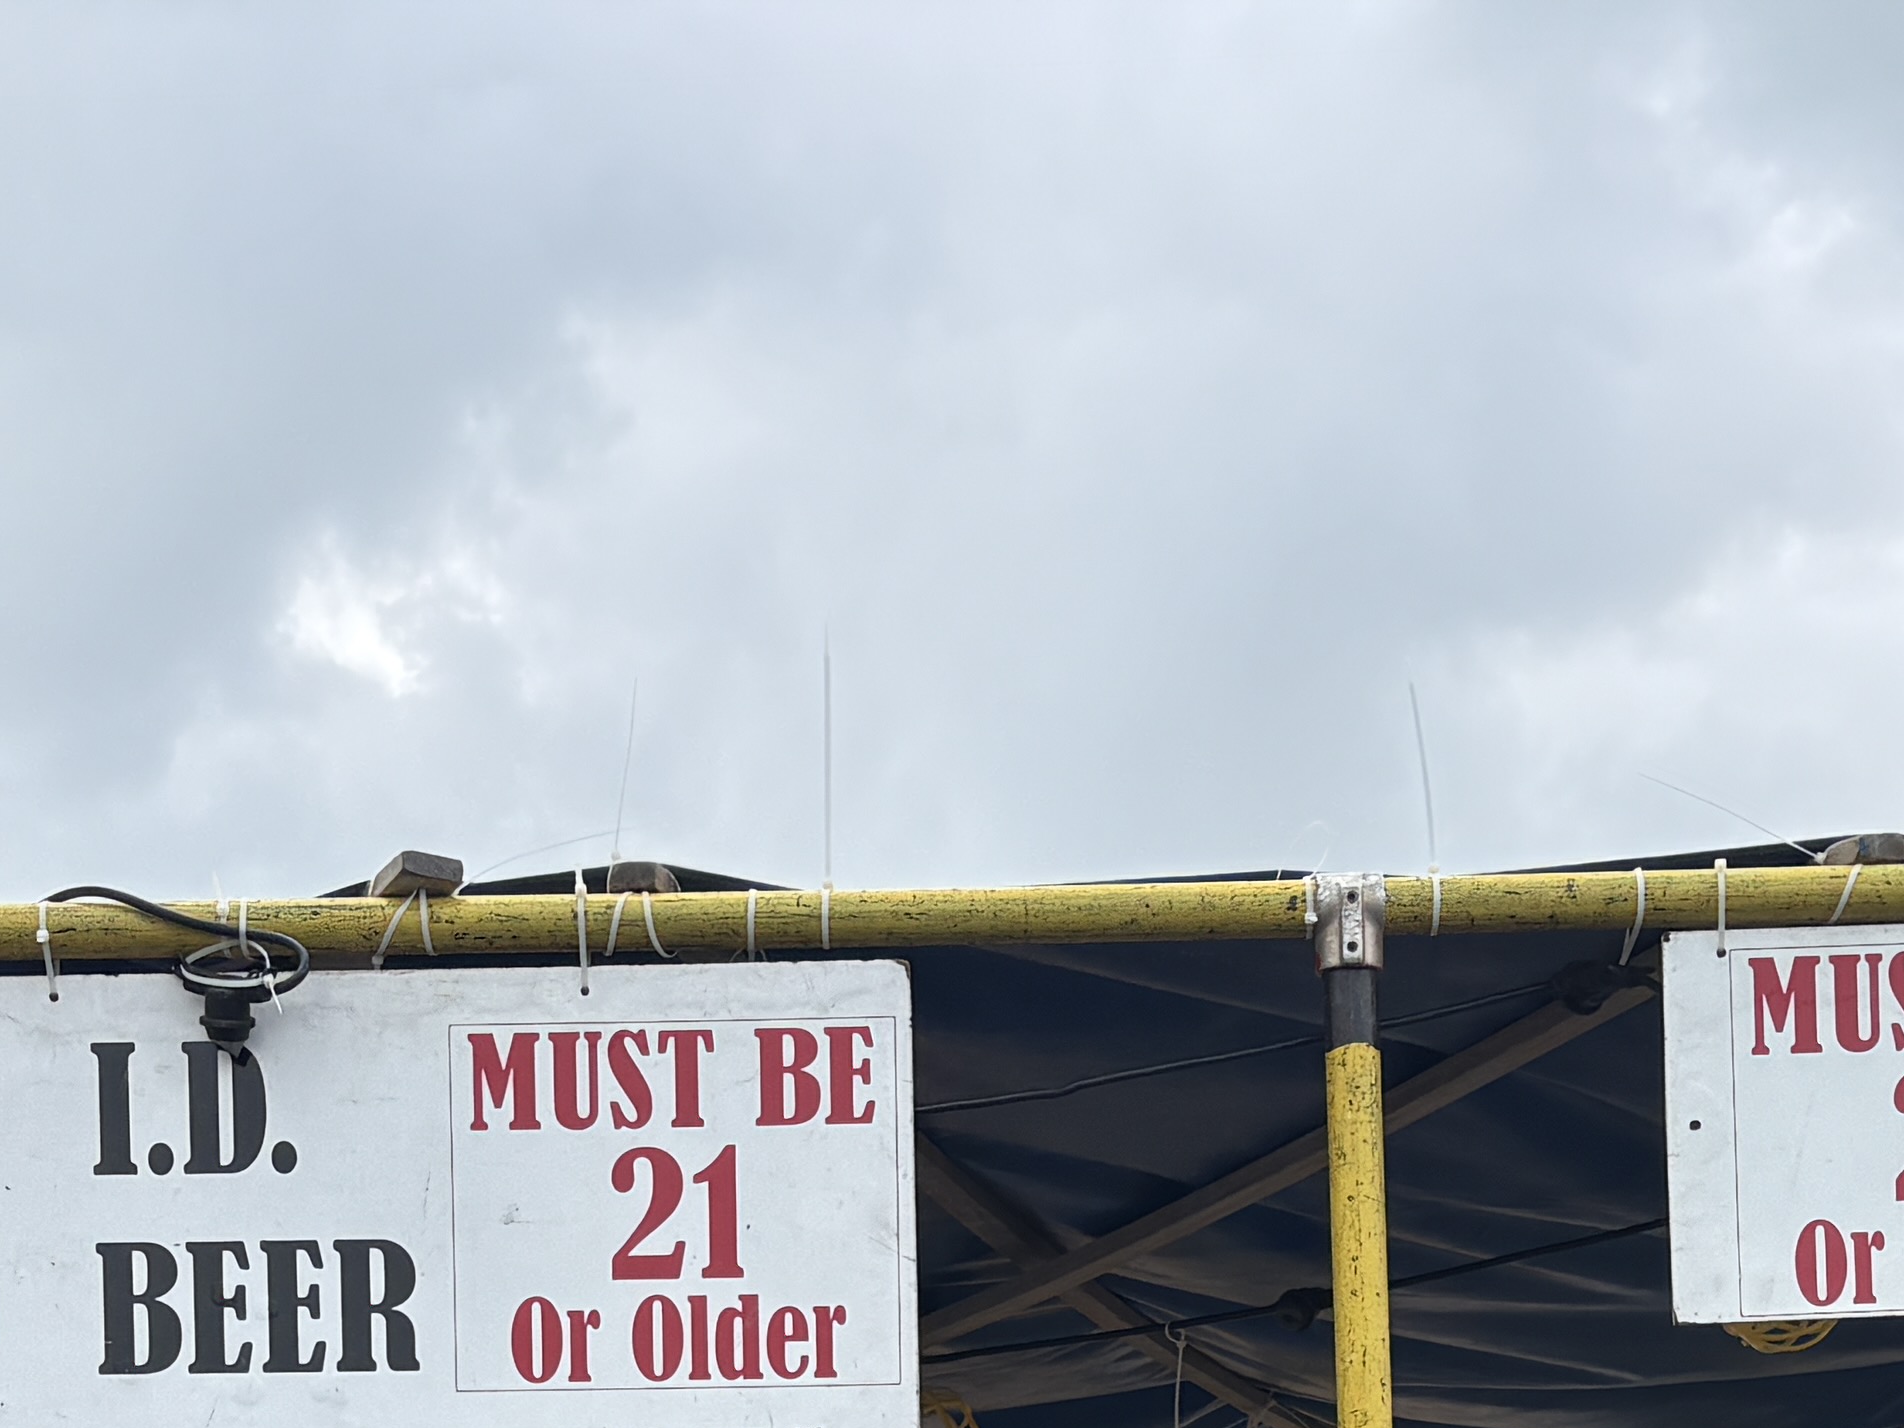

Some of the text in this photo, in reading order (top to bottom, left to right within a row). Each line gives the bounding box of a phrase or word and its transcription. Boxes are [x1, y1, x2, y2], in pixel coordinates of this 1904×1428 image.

[89, 1040, 299, 1177] I.D.
[470, 1025, 875, 1131] MUST BE
[611, 1144, 744, 1281] 21
[1795, 1219, 1885, 1306] Or
[96, 1239, 420, 1376] BEER
[511, 1294, 847, 1384] Or Older
